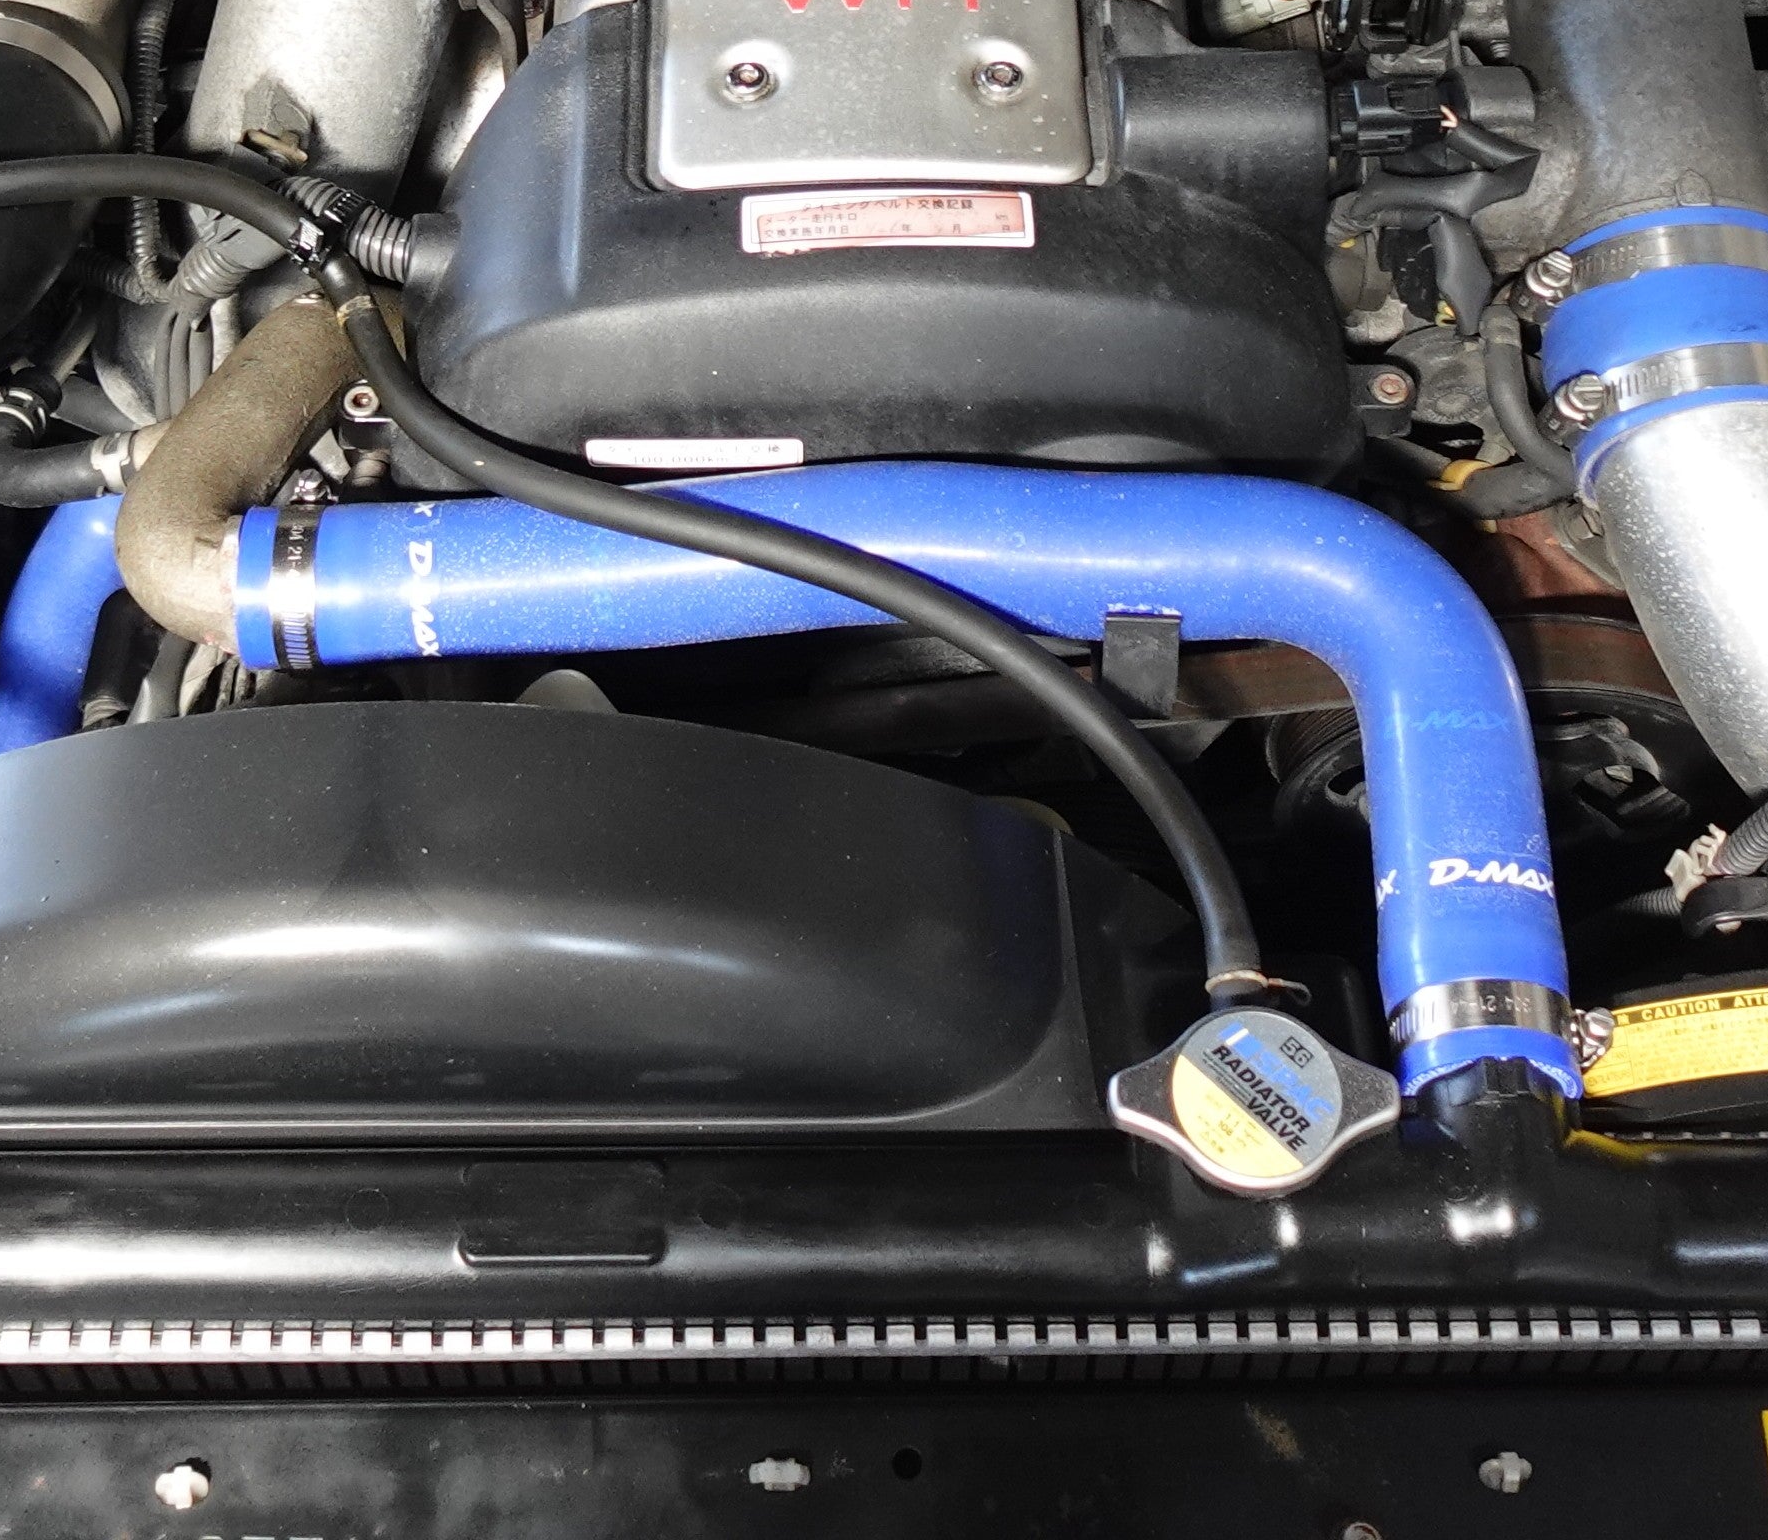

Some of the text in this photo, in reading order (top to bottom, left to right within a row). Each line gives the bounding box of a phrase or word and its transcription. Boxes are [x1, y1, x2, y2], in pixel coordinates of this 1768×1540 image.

[1428, 857, 1555, 898] D-MAX
[1642, 997, 1721, 1022] CAUTION
[1282, 1037, 1311, 1068] 56
[1211, 1044, 1311, 1134] RADIATOR
[1247, 1096, 1309, 1152] VALVE
